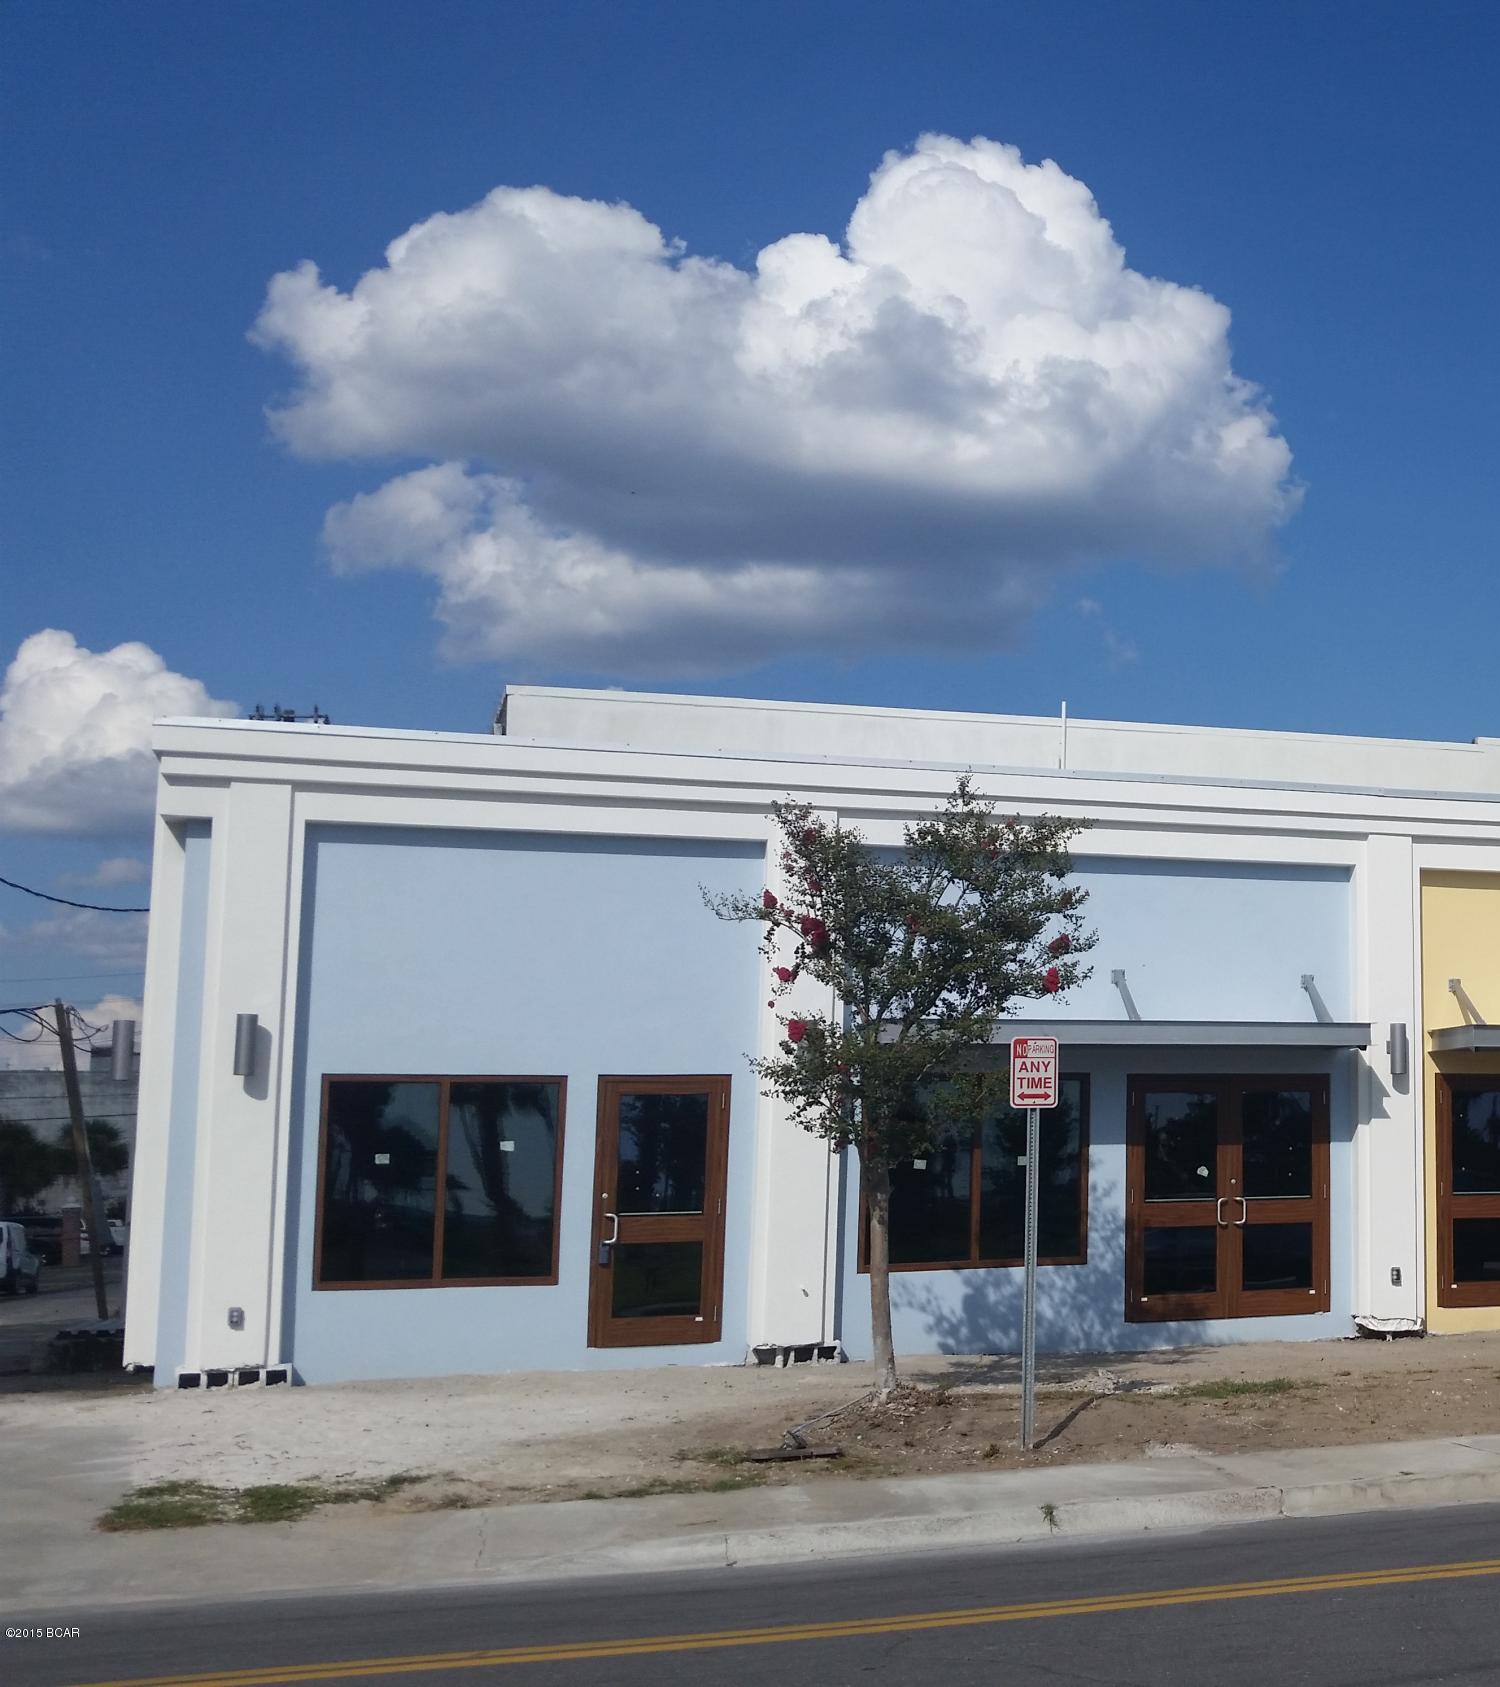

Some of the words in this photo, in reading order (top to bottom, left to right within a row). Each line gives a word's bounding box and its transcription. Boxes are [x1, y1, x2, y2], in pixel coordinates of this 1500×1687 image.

[1016, 1044, 1027, 1056] NO
[1028, 1044, 1054, 1054] PARKING
[1019, 1060, 1051, 1073] ANY
[1017, 1077, 1052, 1089] TIME
